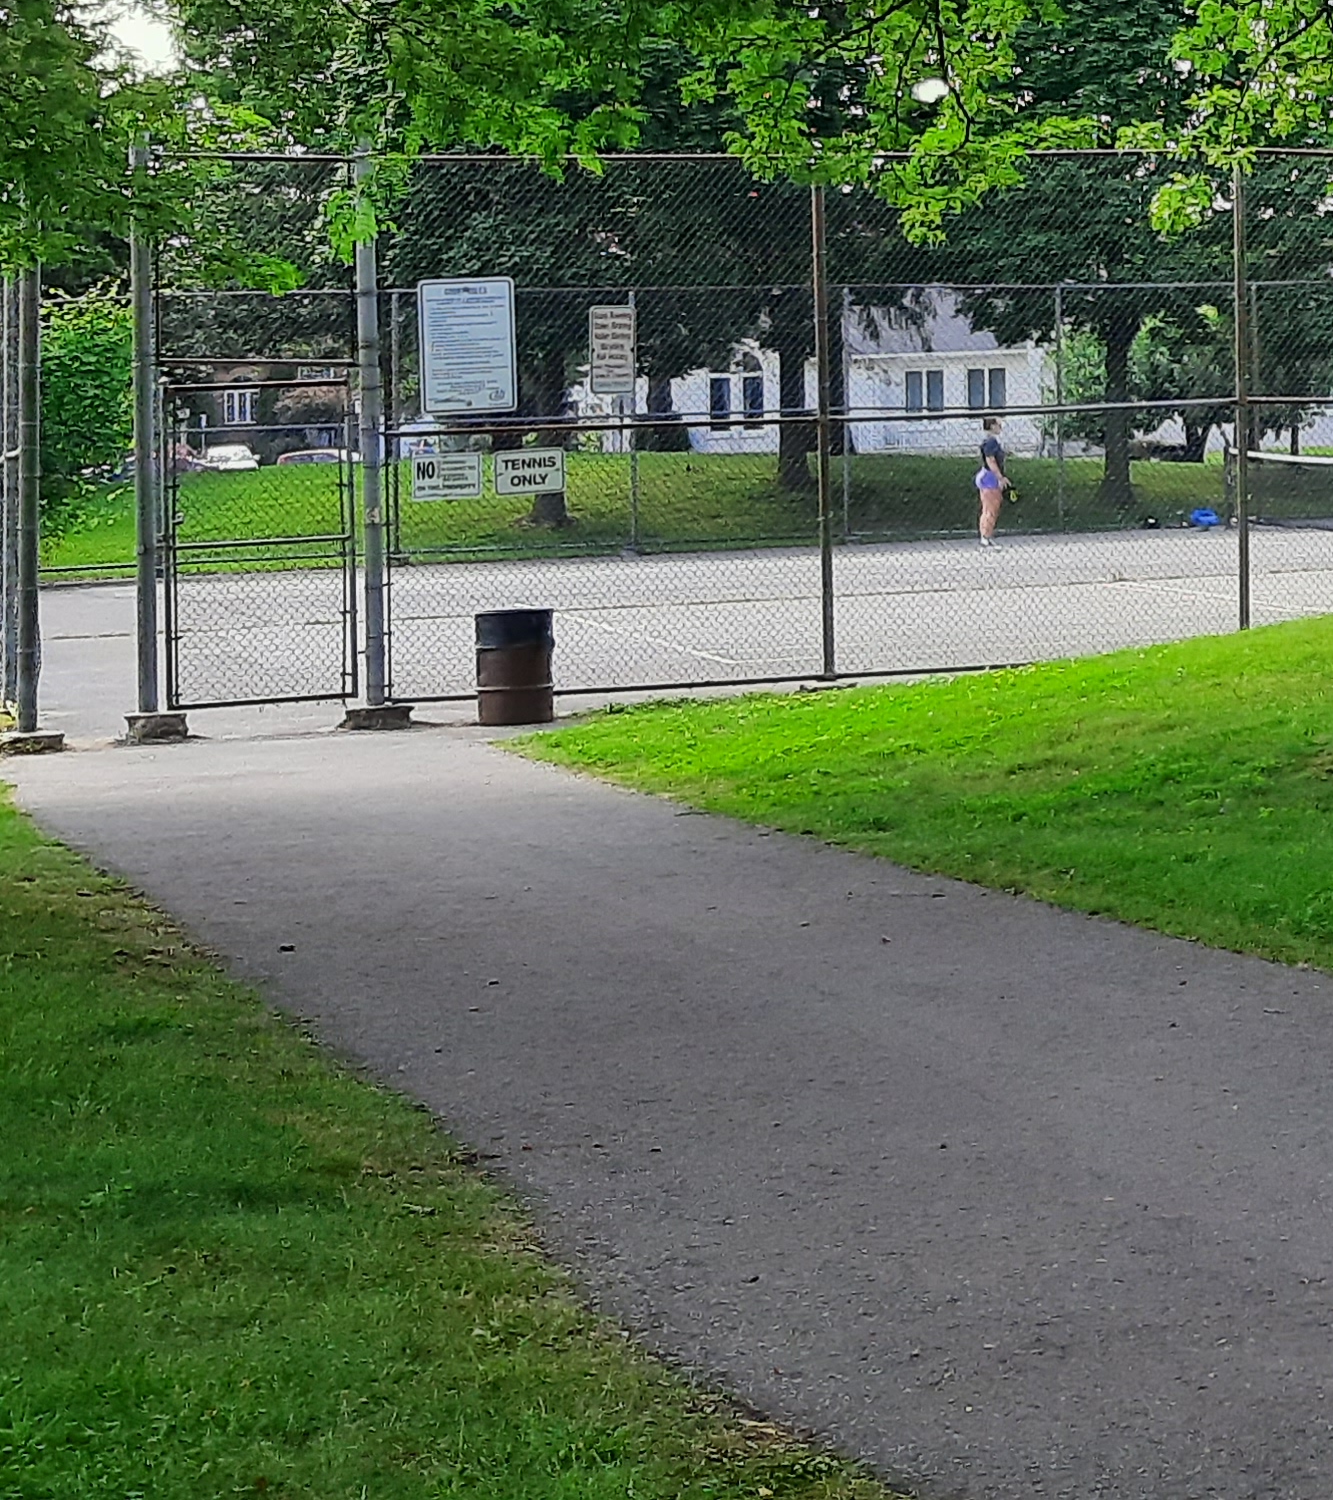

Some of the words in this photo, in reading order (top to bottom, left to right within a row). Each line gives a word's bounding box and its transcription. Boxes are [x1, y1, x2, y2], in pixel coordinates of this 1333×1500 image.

[416, 461, 435, 481] NO
[501, 456, 557, 471] TENNIS
[510, 473, 549, 487] ONLY
